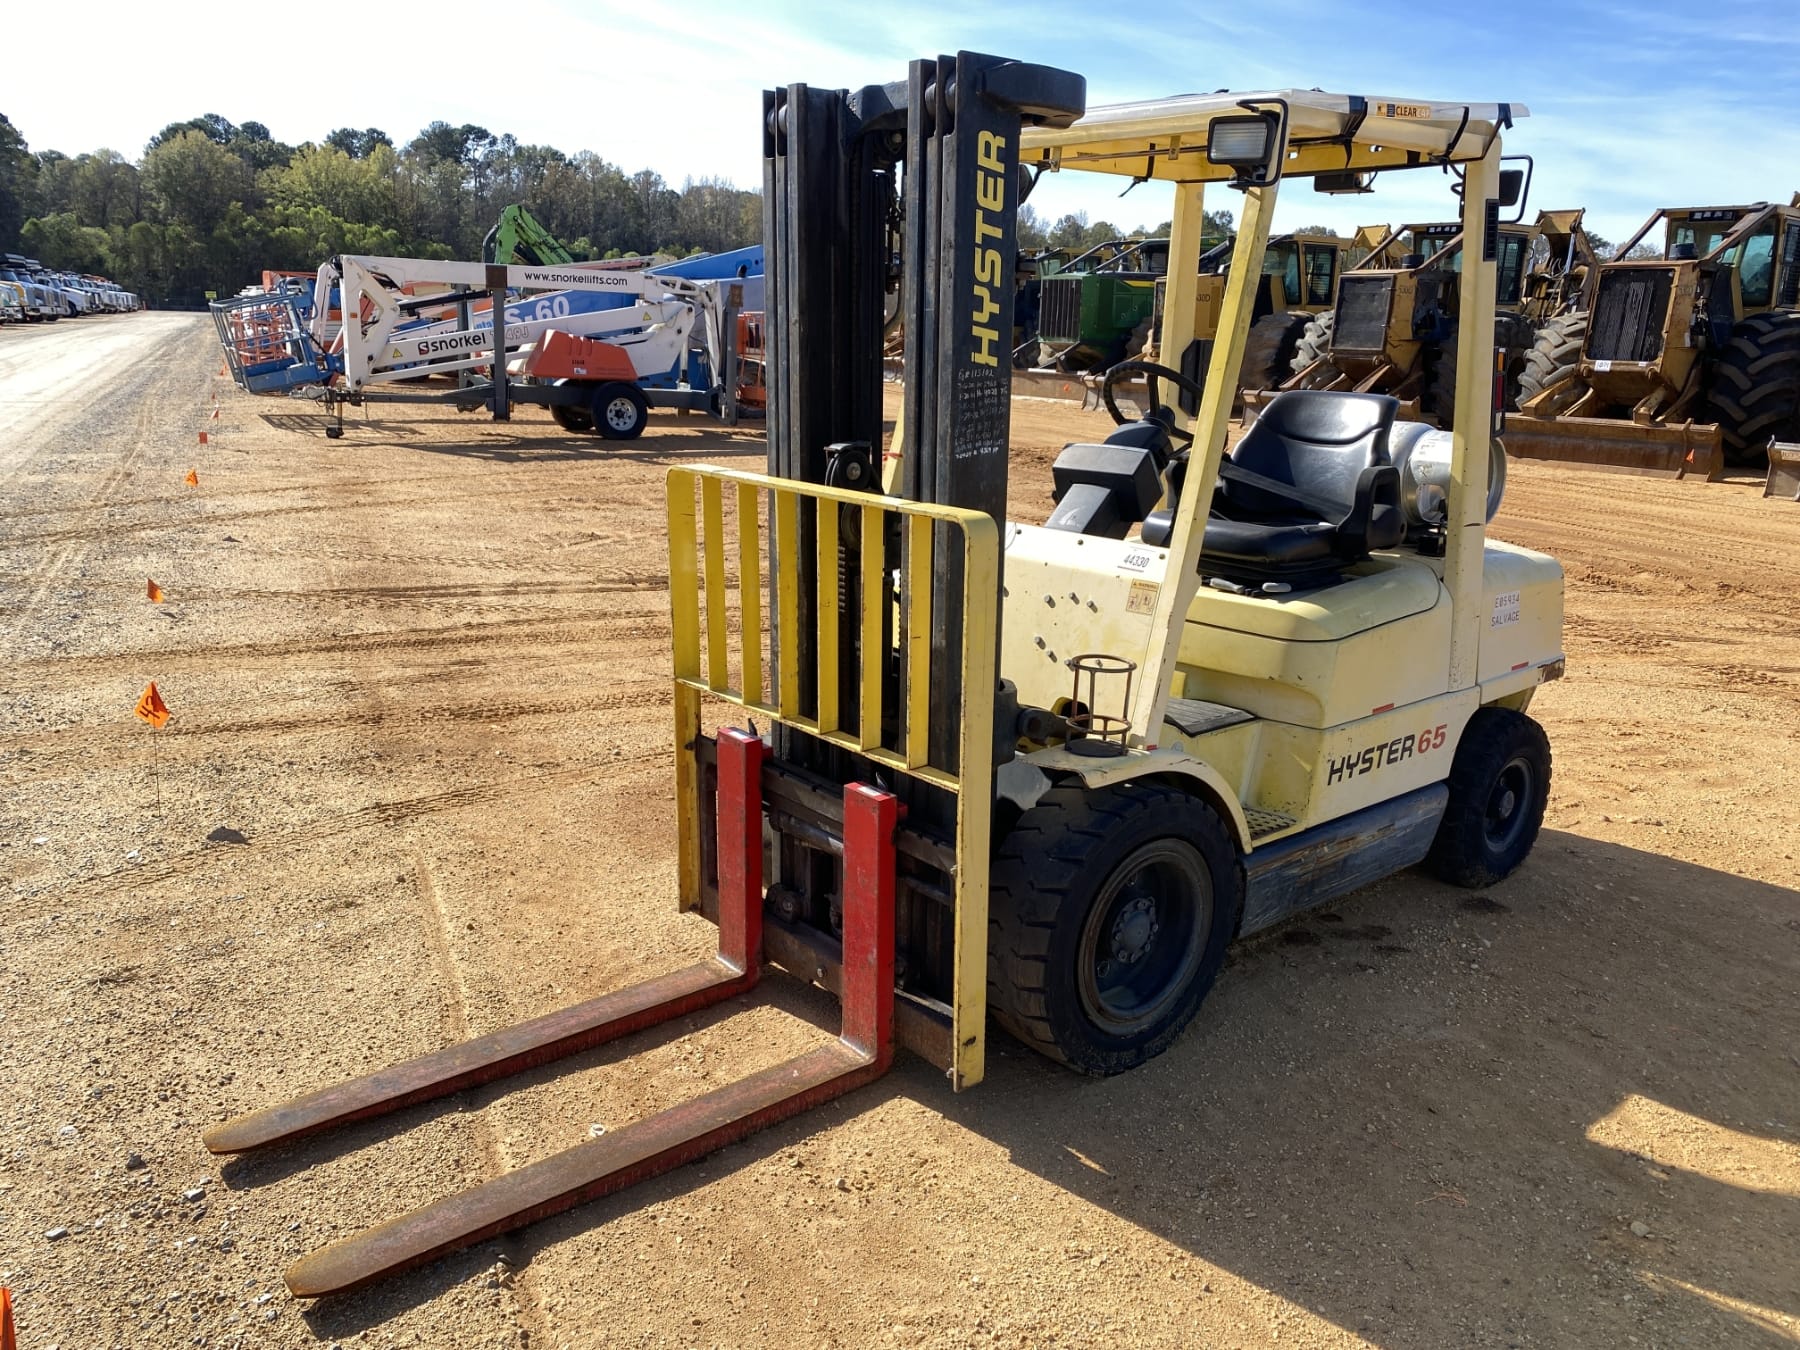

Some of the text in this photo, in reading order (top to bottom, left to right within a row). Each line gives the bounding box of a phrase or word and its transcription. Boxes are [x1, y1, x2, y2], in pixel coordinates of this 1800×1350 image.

[971, 129, 1006, 368] HYSTER
[524, 272, 628, 286] www.snorkellifts.com
[431, 332, 487, 352] snorkel
[1123, 554, 1150, 568] 44330
[1491, 610, 1520, 627] SALVAGE
[1327, 724, 1447, 785] HYSTER 65
